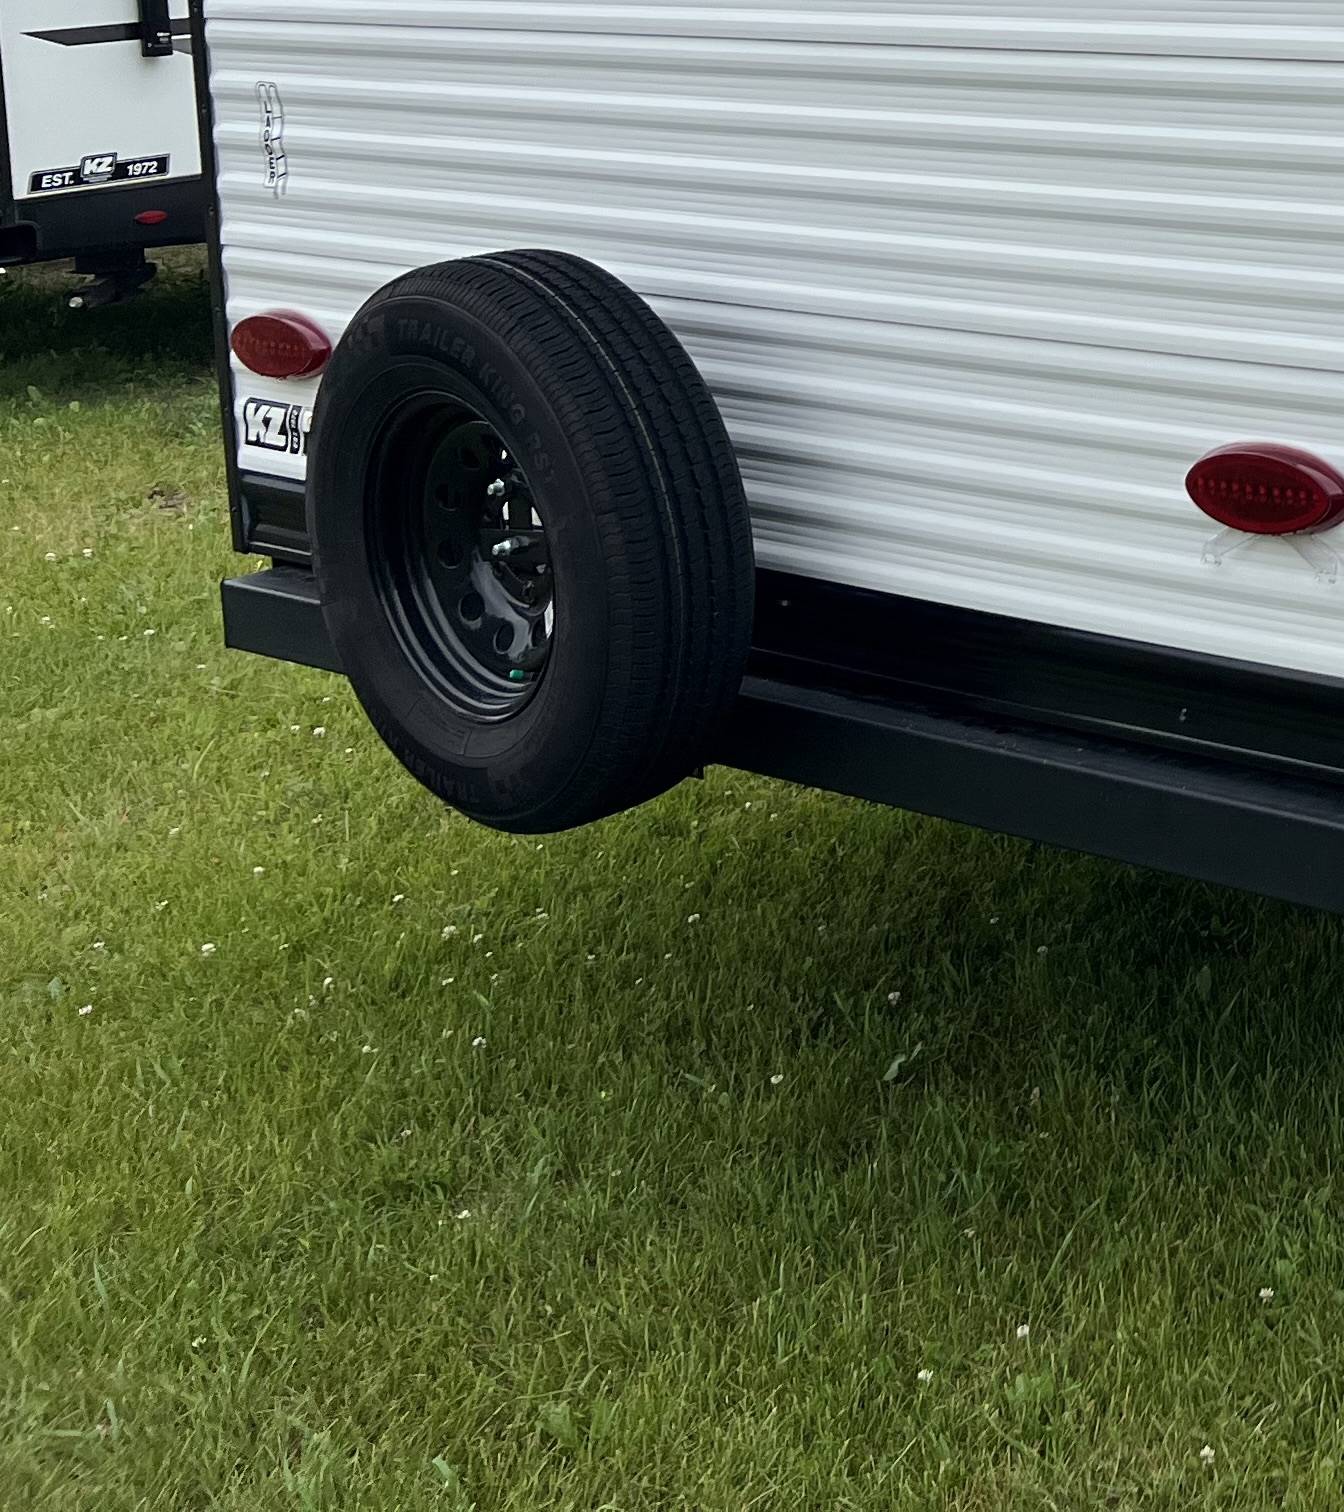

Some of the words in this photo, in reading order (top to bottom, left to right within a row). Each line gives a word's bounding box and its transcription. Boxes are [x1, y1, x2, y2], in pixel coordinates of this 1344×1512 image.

[41, 172, 75, 188] EST.
[83, 156, 114, 175] KZ
[126, 160, 158, 177] 1972
[396, 318, 476, 369] TRAILER
[478, 362, 526, 426] KING
[245, 402, 288, 447] KZ
